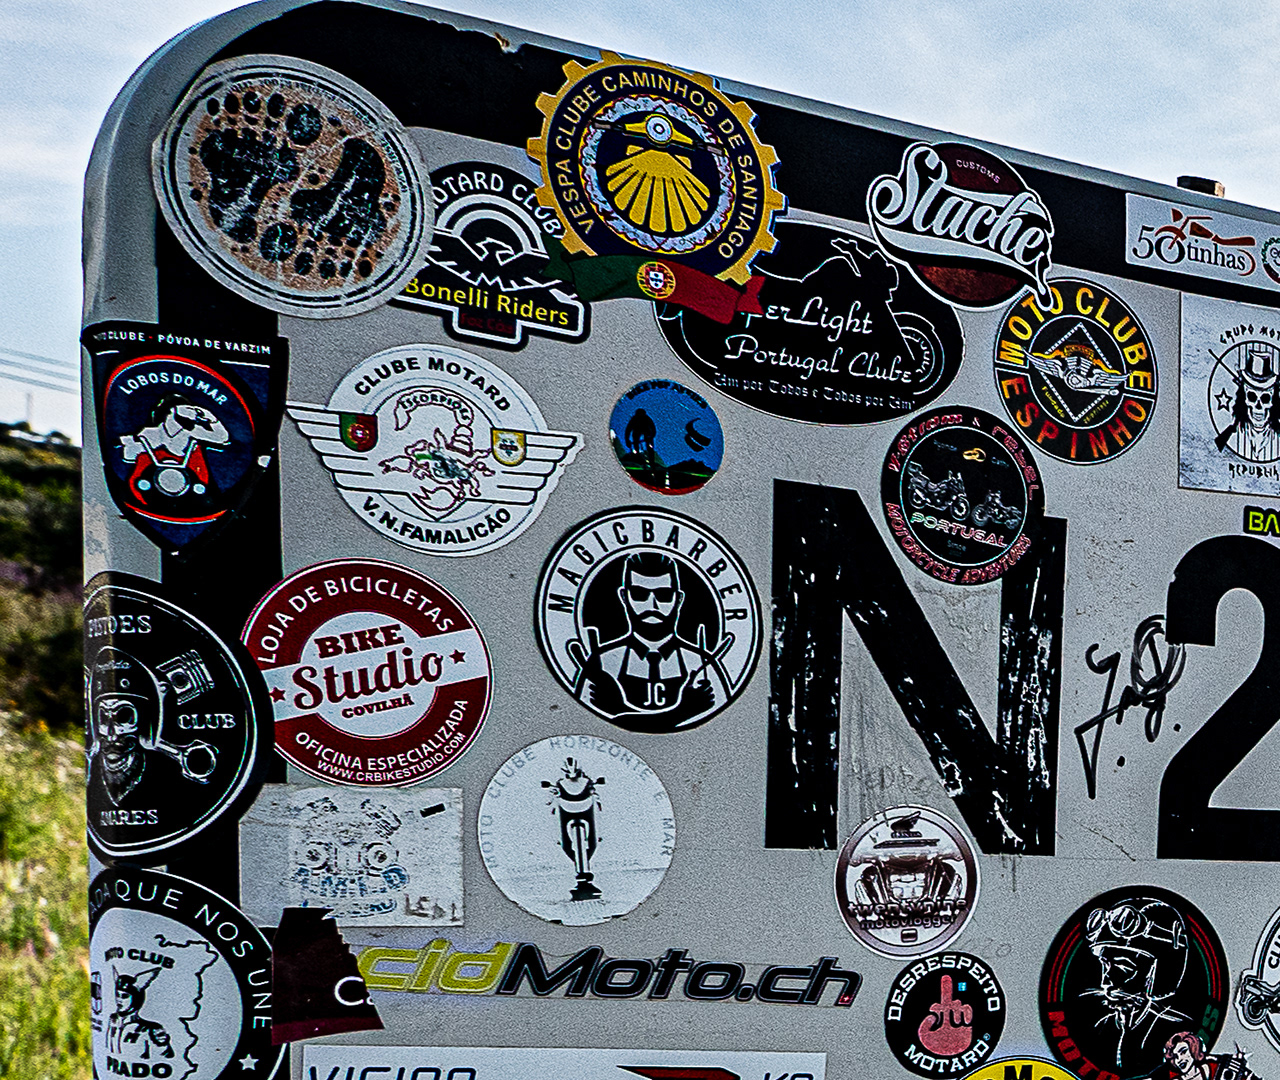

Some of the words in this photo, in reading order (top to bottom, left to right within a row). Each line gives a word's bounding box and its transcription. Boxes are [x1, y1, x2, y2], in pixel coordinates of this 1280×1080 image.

[557, 85, 601, 150] CLUBE
[602, 70, 718, 118] CAMINHOS
[720, 119, 745, 149] DE
[556, 157, 597, 234] VESPA
[720, 154, 758, 260] SANTIAGO
[405, 278, 489, 310] Bonelli
[496, 293, 569, 326] Riders
[158, 333, 200, 347] PÓVOA
[204, 338, 221, 350] DE
[1219, 323, 1255, 345] GRUPO
[724, 334, 844, 380] Portugal
[849, 352, 912, 384] Clube
[118, 372, 170, 396] LOBOS
[173, 372, 195, 388] DO
[196, 379, 229, 406] MAR
[354, 356, 423, 397] CLUBE
[427, 356, 513, 412] MOTARD
[1000, 377, 1147, 460] ESPINHO
[909, 511, 1009, 548] PORTUGAL
[257, 609, 295, 664] LOJA
[288, 585, 322, 612] DE
[324, 574, 454, 632] BICICLETAS
[313, 623, 405, 660] BIKE
[292, 647, 444, 711] Studio
[295, 731, 364, 771] OFICINA
[367, 698, 469, 772] ESPECIALIZADA
[317, 733, 467, 782] WWW.CRBIKESTUDIO.COM
[886, 955, 1002, 1023] DESRESPEITO
[904, 1040, 988, 1074] MOTARD
